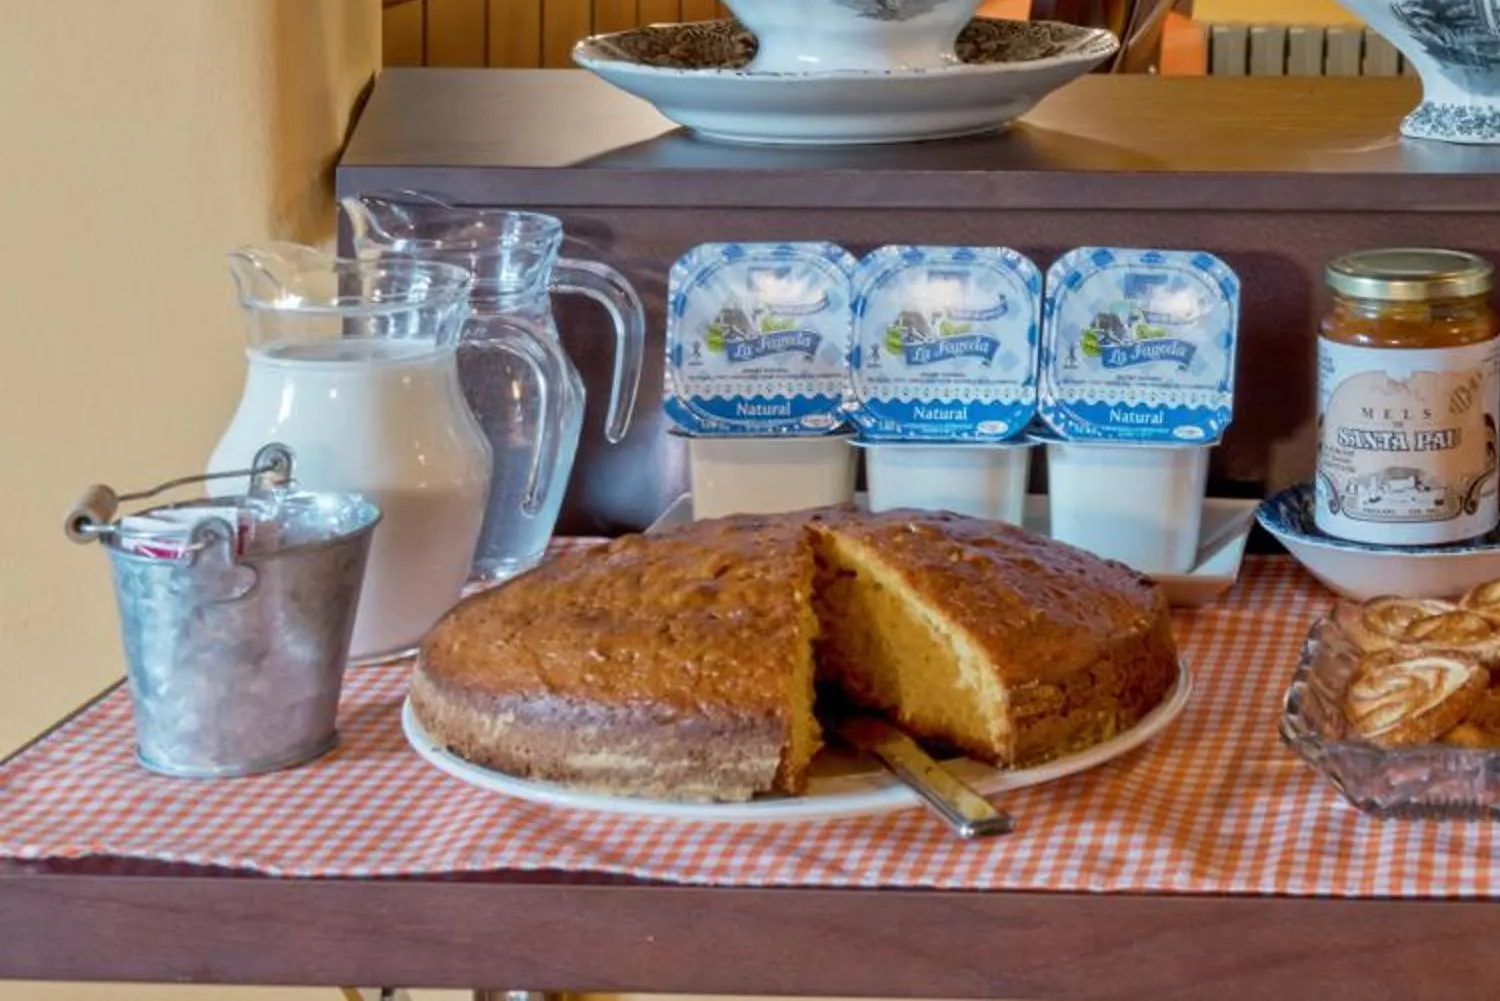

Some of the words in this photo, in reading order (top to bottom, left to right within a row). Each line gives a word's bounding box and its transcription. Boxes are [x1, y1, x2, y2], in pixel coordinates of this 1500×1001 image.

[912, 348, 931, 362] La
[1108, 351, 1127, 365] La
[736, 401, 792, 417] Natural
[913, 406, 968, 421] Natural
[1108, 408, 1165, 425] Natural
[1337, 426, 1411, 452] SANTA
